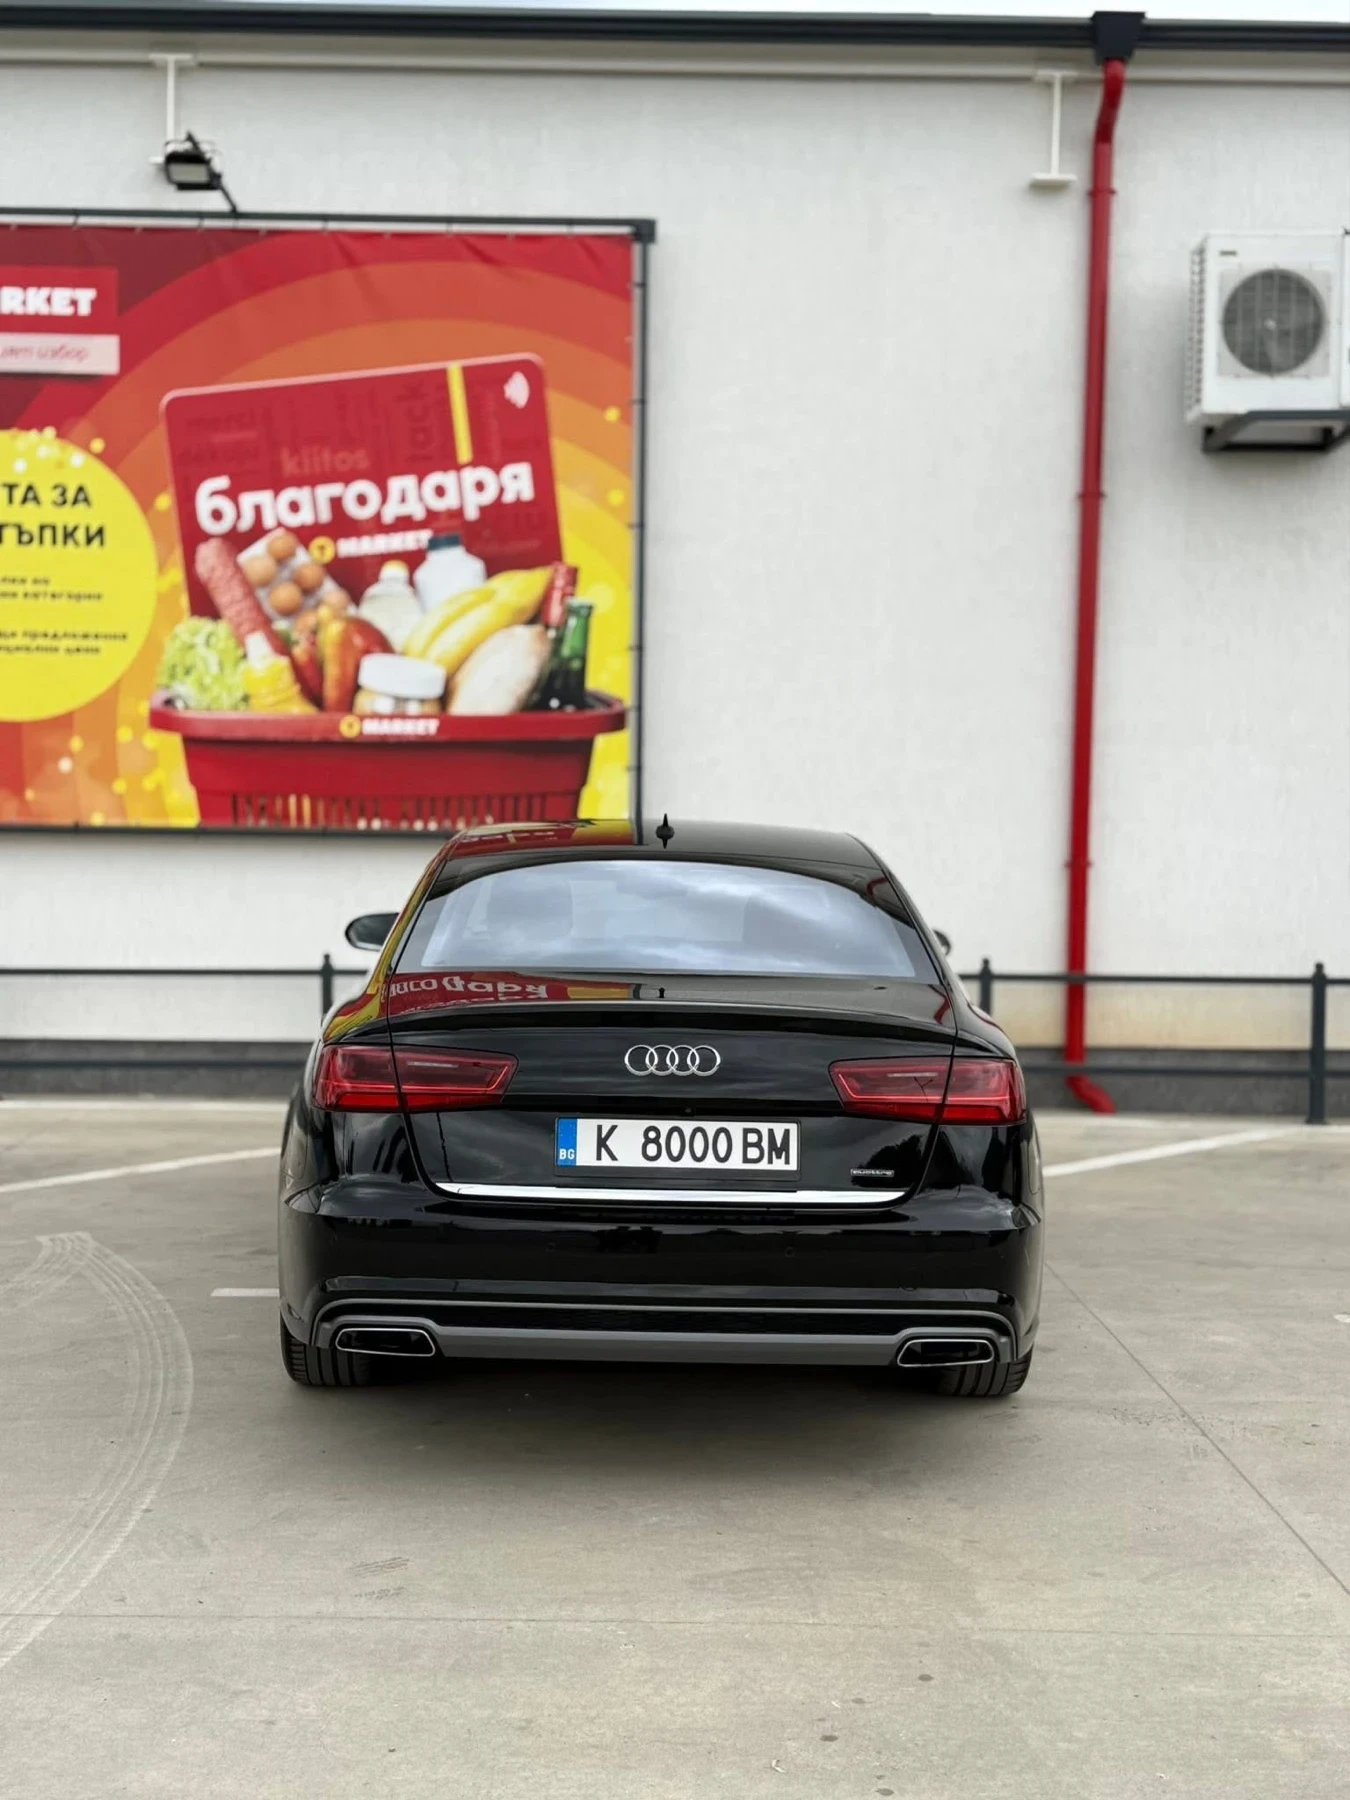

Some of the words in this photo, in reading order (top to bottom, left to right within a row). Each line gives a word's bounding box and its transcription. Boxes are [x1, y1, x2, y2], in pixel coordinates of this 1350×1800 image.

[0, 286, 97, 317] RKET
[51, 483, 91, 507] ЗА
[195, 461, 535, 535] благодаря
[336, 528, 434, 558] MARKET
[362, 717, 440, 736] MARKET
[559, 1149, 575, 1160] BG
[595, 1124, 619, 1162] K
